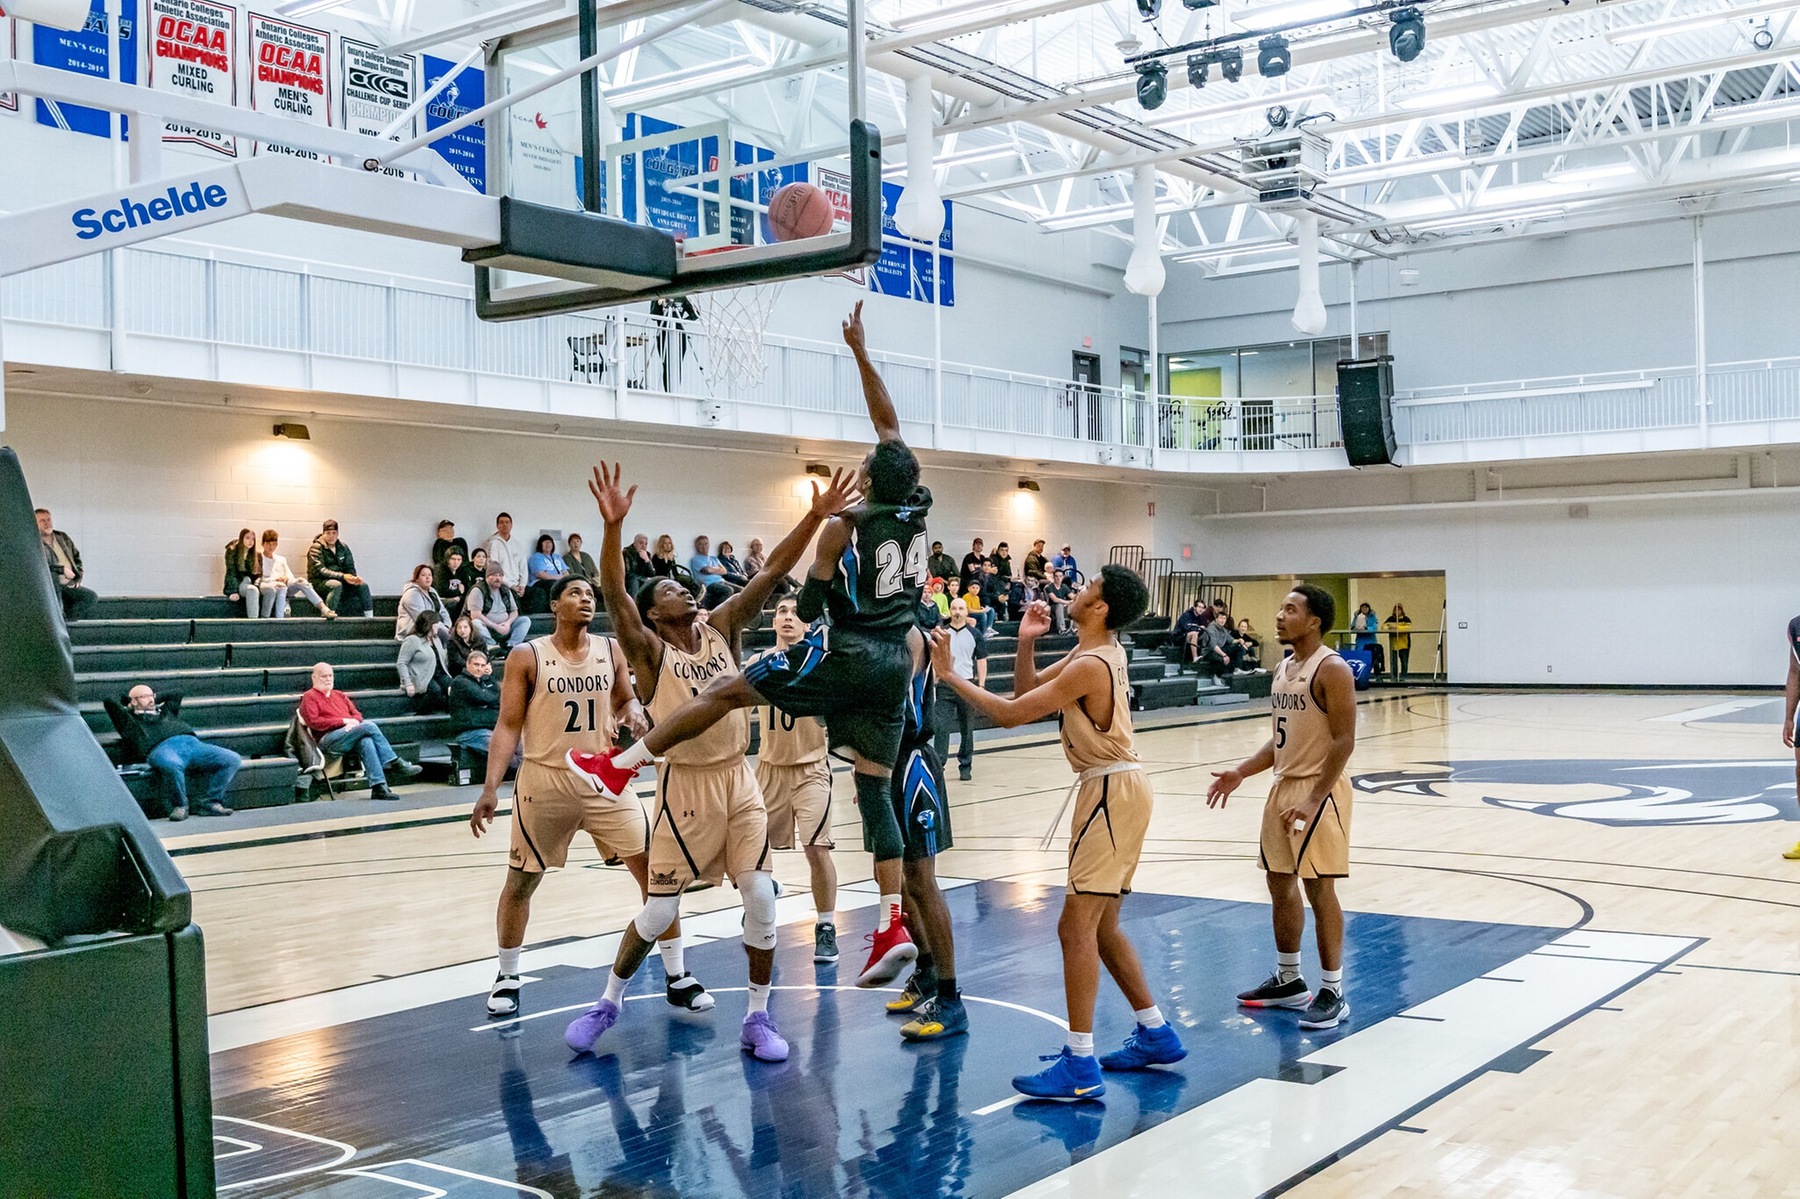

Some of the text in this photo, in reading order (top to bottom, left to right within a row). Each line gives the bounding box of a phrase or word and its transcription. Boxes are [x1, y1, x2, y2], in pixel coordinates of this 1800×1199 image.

[153, 2, 230, 30] Athletic Association
[190, 2, 224, 19] Colleges
[157, 14, 228, 54] OCAA
[255, 29, 325, 54] Athletic Association
[260, 21, 319, 44] Ontario Colleges
[59, 37, 108, 56] MEN'S GOL
[156, 39, 228, 73] CHAMPIONS
[347, 46, 364, 58] Ontario
[365, 51, 385, 64] Colleges
[68, 58, 104, 73] 2014-2015
[258, 40, 323, 78] OCAA
[360, 58, 379, 71] Campus
[380, 63, 404, 77] Recreation
[178, 63, 208, 80] MIXED
[258, 65, 324, 96] CHAMPIONS
[171, 74, 214, 94] CURLING
[278, 87, 309, 104] MEN'S
[273, 98, 313, 116] CURLING
[346, 87, 378, 103] CHALLENGE
[379, 96, 392, 106] CUP
[72, 181, 228, 239] Schelde
[875, 530, 929, 599] 24
[674, 652, 728, 681] CONDORS
[547, 674, 609, 694] CONDORS
[563, 698, 597, 733] 21
[1276, 716, 1287, 750] 5
